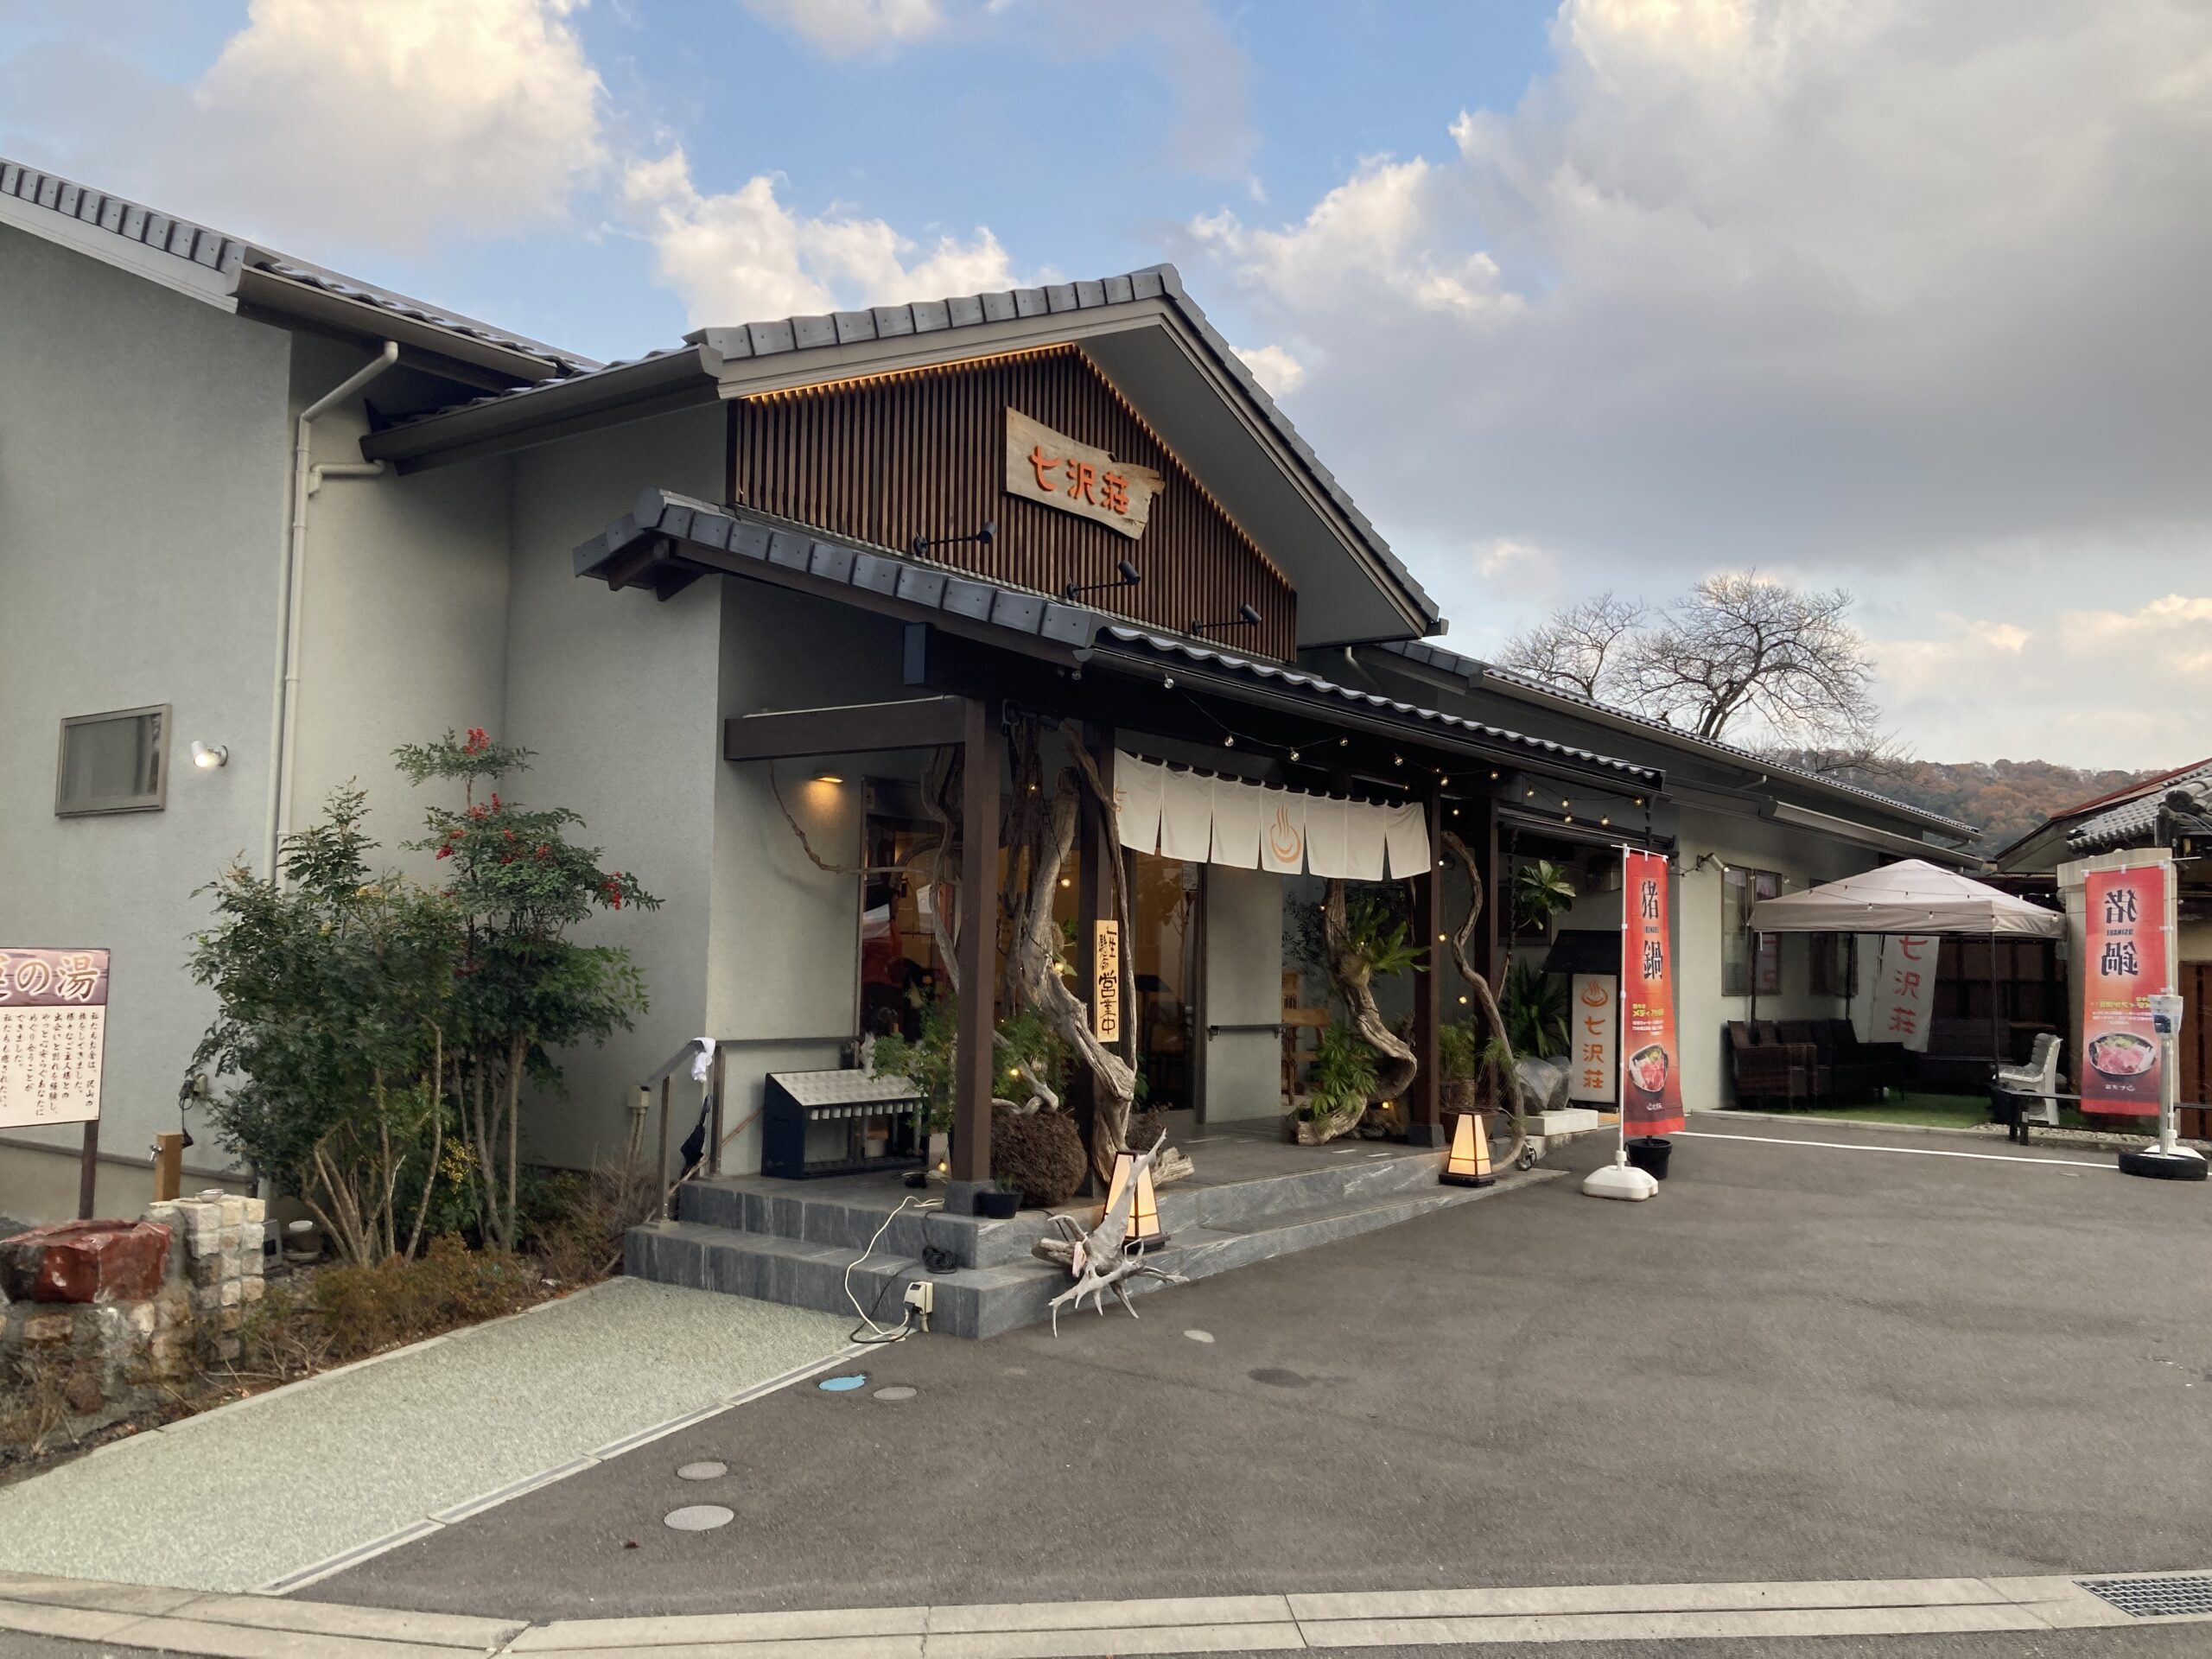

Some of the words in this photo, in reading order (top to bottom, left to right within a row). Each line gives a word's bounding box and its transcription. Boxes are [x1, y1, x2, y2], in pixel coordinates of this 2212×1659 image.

[1027, 445, 1129, 515] 七沢荘
[1889, 935, 1929, 1034] 七沢荘
[14, 1014, 25, 1067] できました。
[1582, 1015, 1606, 1089] 七沢荘
